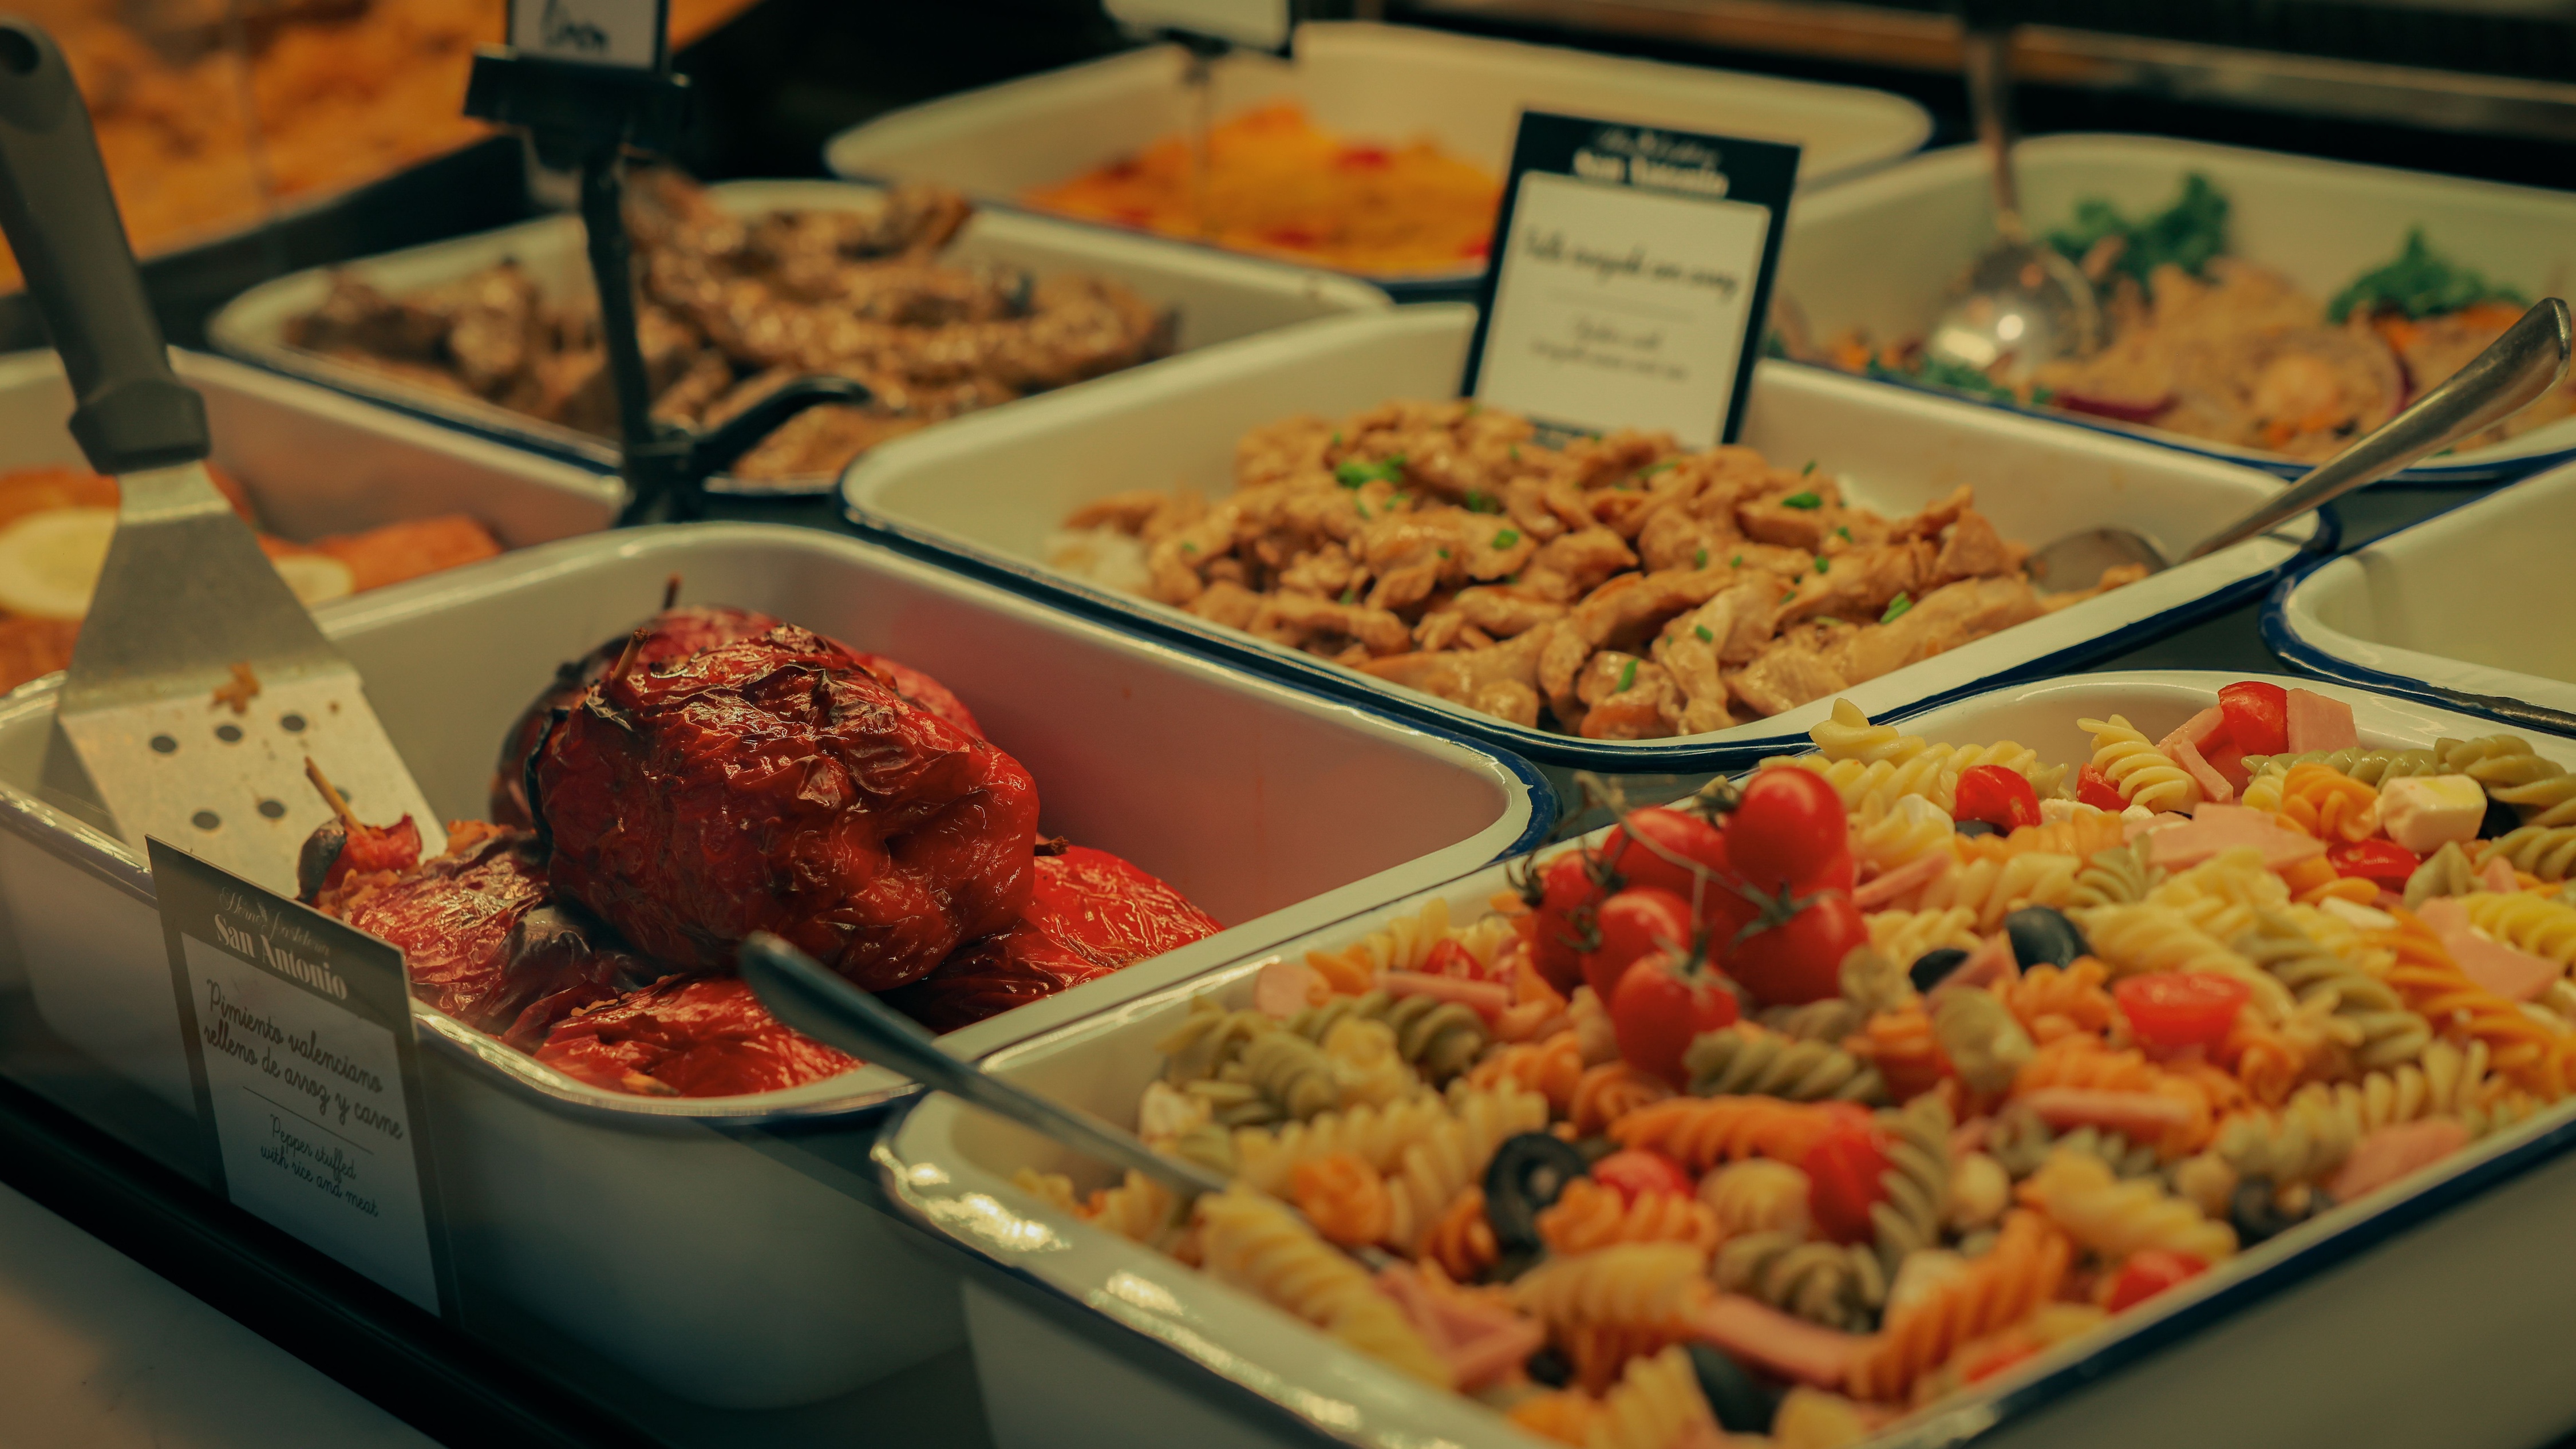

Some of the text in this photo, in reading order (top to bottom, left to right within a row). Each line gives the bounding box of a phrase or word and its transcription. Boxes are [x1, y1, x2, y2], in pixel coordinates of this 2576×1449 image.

[214, 914, 347, 1000] San Antonio
[206, 978, 384, 1093] Pimiento valenciano
[204, 1018, 404, 1140] relleno de arroz y carne
[260, 1145, 379, 1218] with rice and meat
[270, 1113, 357, 1183] Pepper stuffed
